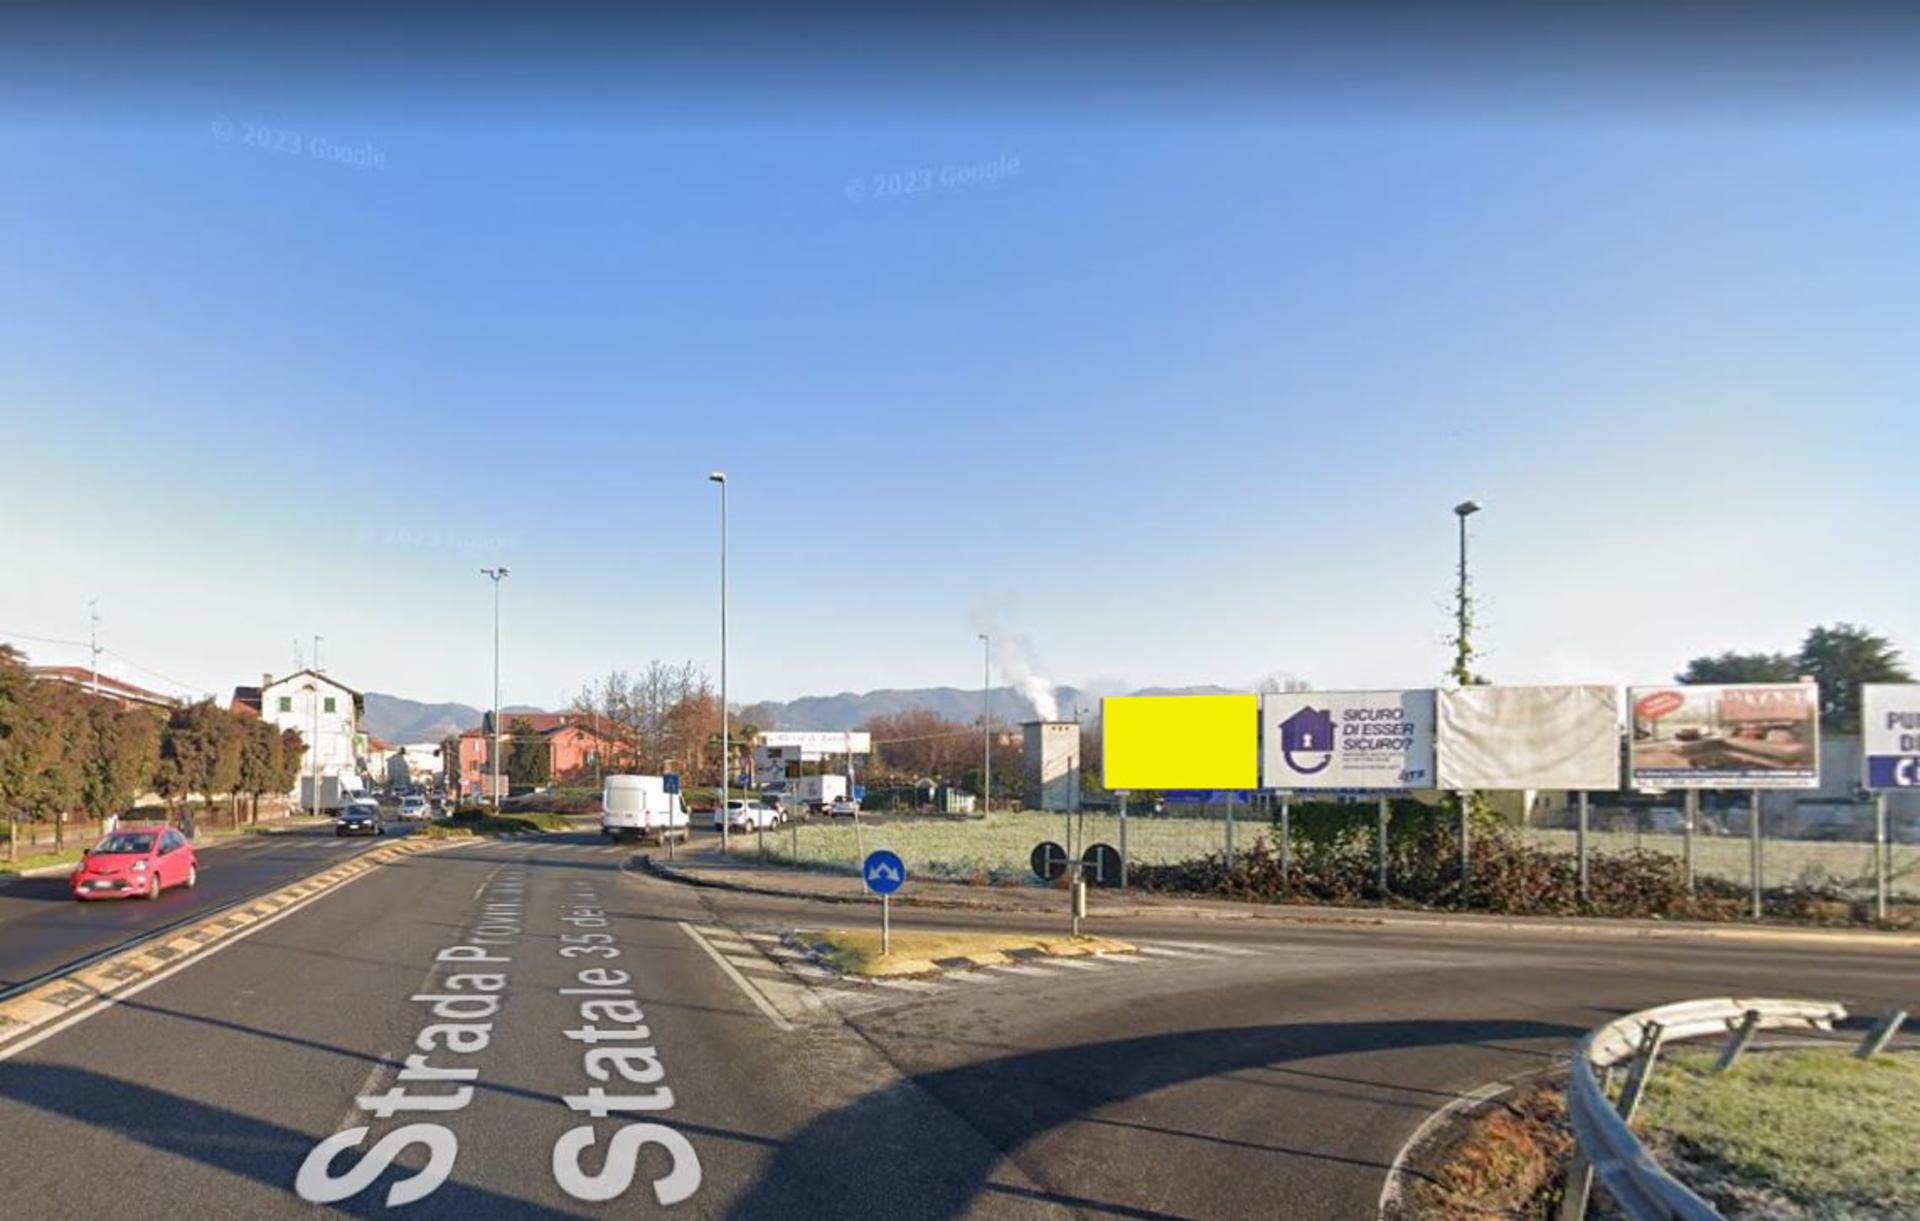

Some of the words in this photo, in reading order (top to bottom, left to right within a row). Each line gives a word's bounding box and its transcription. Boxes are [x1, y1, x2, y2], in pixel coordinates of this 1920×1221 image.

[1343, 708, 1404, 721] SICURO
[1343, 723, 1359, 735] DI
[1362, 723, 1415, 735] ESSER
[1343, 737, 1414, 751] SICURO?
